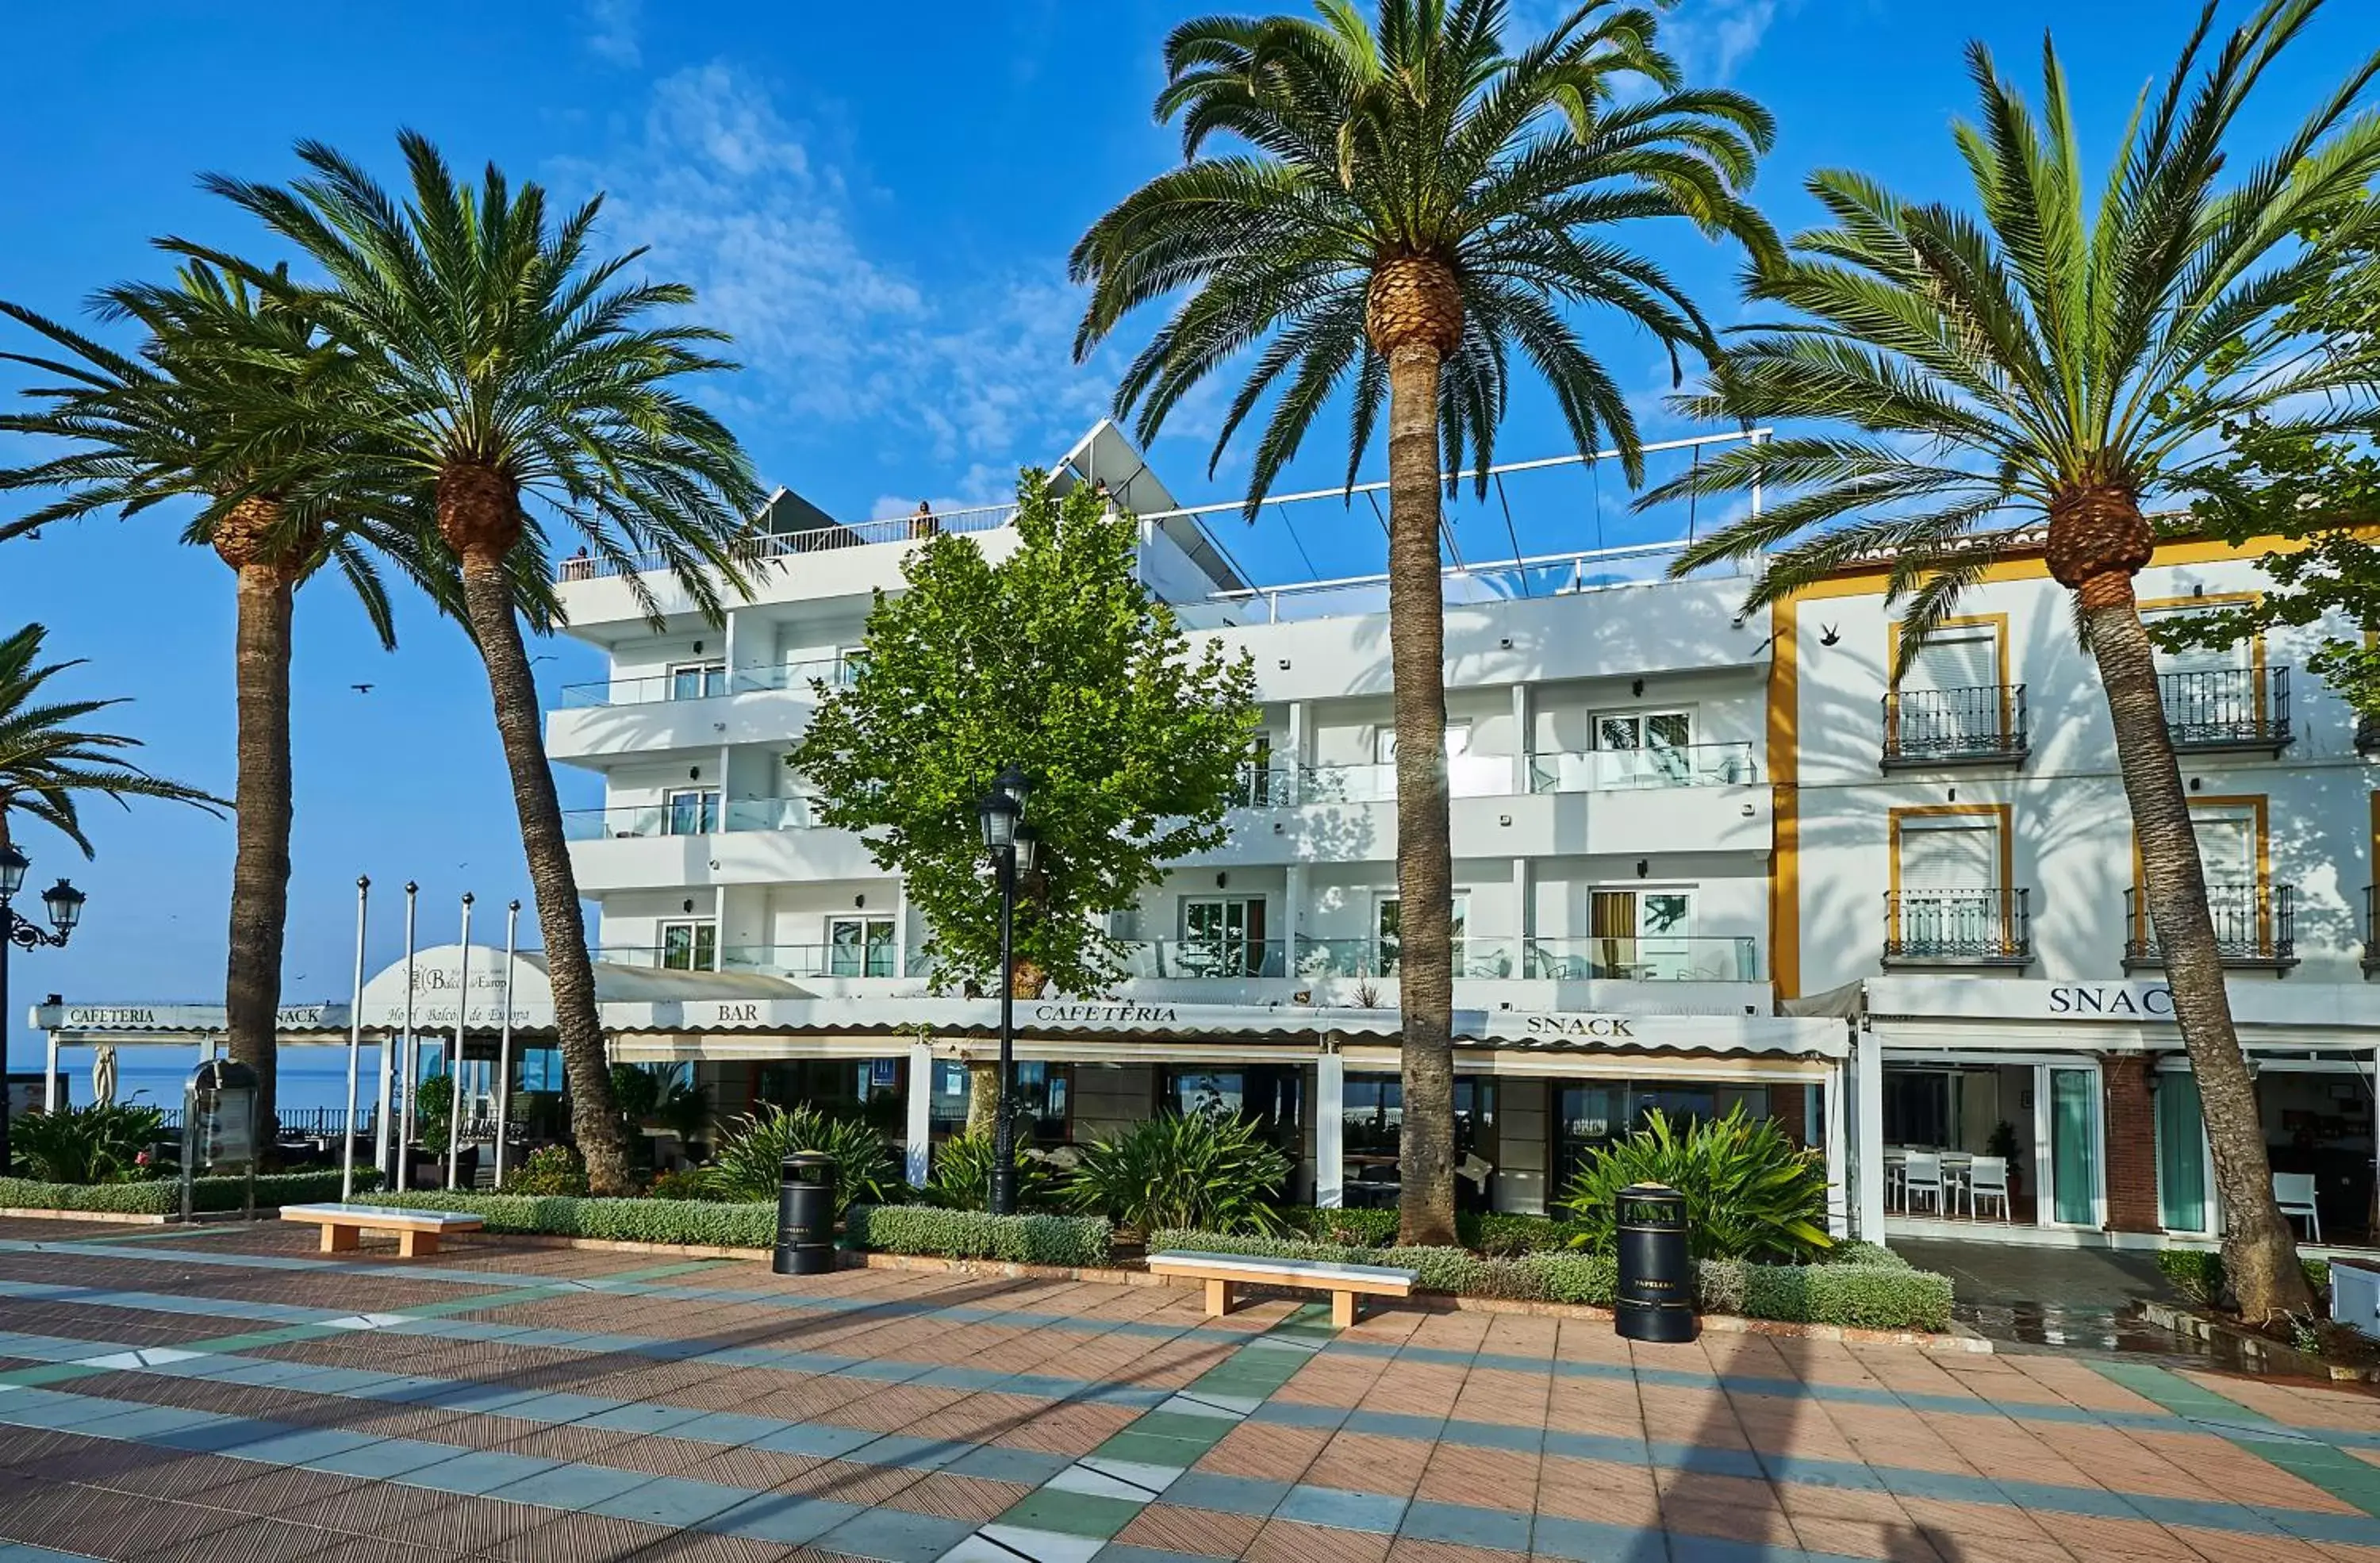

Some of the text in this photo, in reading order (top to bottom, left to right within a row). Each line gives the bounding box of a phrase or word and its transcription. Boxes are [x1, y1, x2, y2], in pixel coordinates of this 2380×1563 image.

[478, 976, 507, 992] Europ
[2049, 988, 2174, 1015] SNAC
[70, 1008, 155, 1023] CAFETERIA
[276, 1008, 319, 1022] NACK
[717, 1004, 759, 1021] BAR
[1035, 1004, 1178, 1022] CAFETERIA
[1527, 1016, 1634, 1037] SNACK
